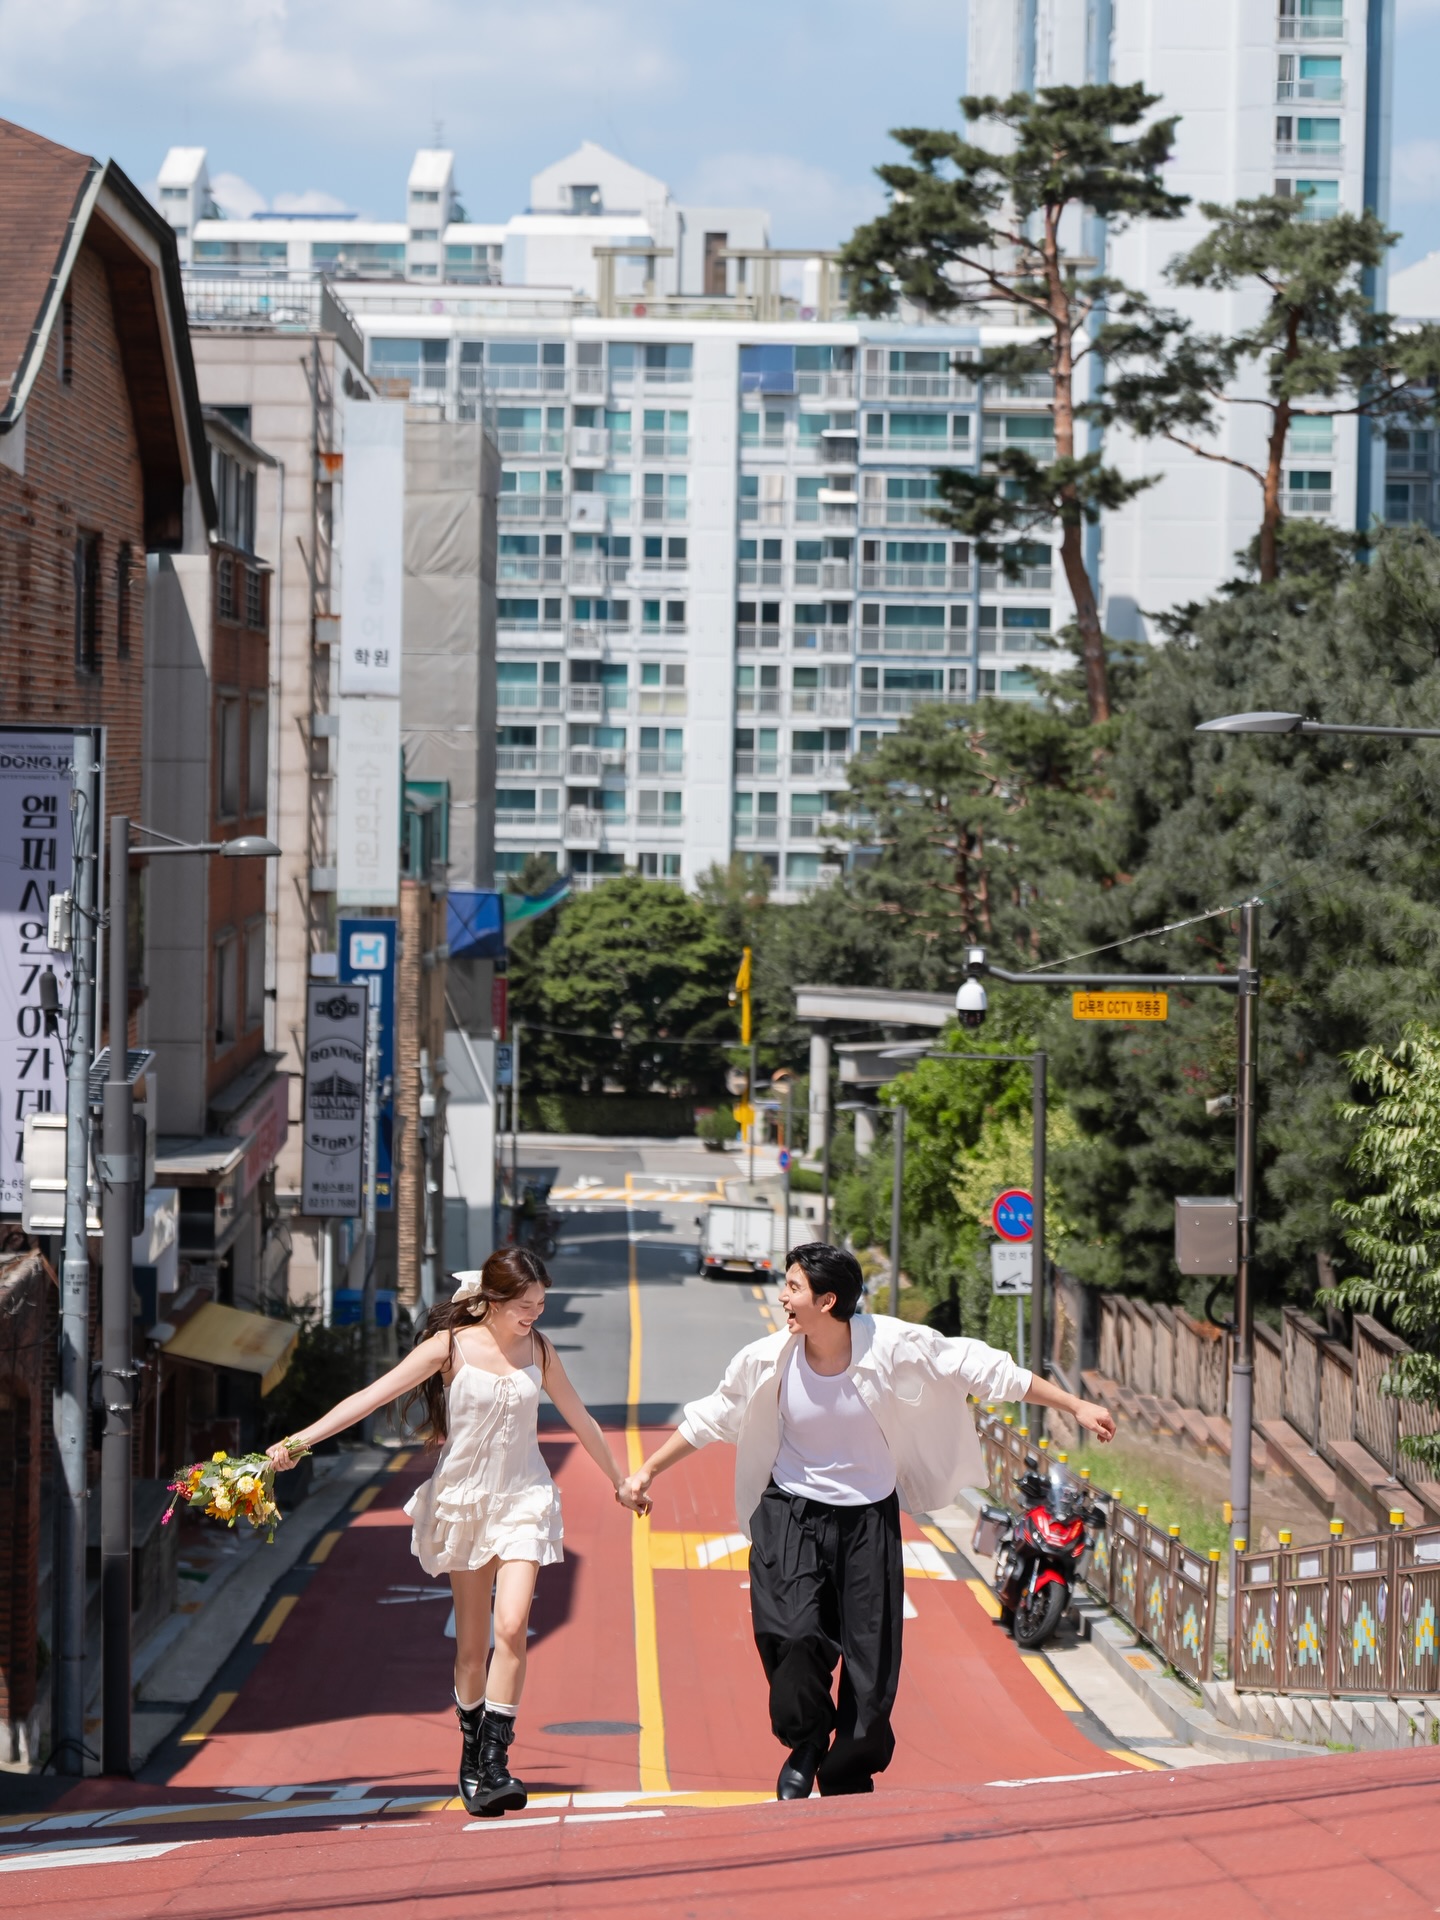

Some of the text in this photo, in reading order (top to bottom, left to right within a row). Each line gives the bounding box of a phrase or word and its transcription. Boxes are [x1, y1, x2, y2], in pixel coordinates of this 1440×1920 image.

[355, 648, 389, 667] 학원
[0, 755, 71, 770] DONG.H
[1079, 1000, 1160, 1017] 다목적 CCTV 작동중
[311, 1045, 362, 1064] BOXING
[310, 1095, 360, 1109] BOXING
[313, 1109, 355, 1120] STORY
[311, 1133, 356, 1151] STORY
[998, 1251, 1033, 1261] 견인지
